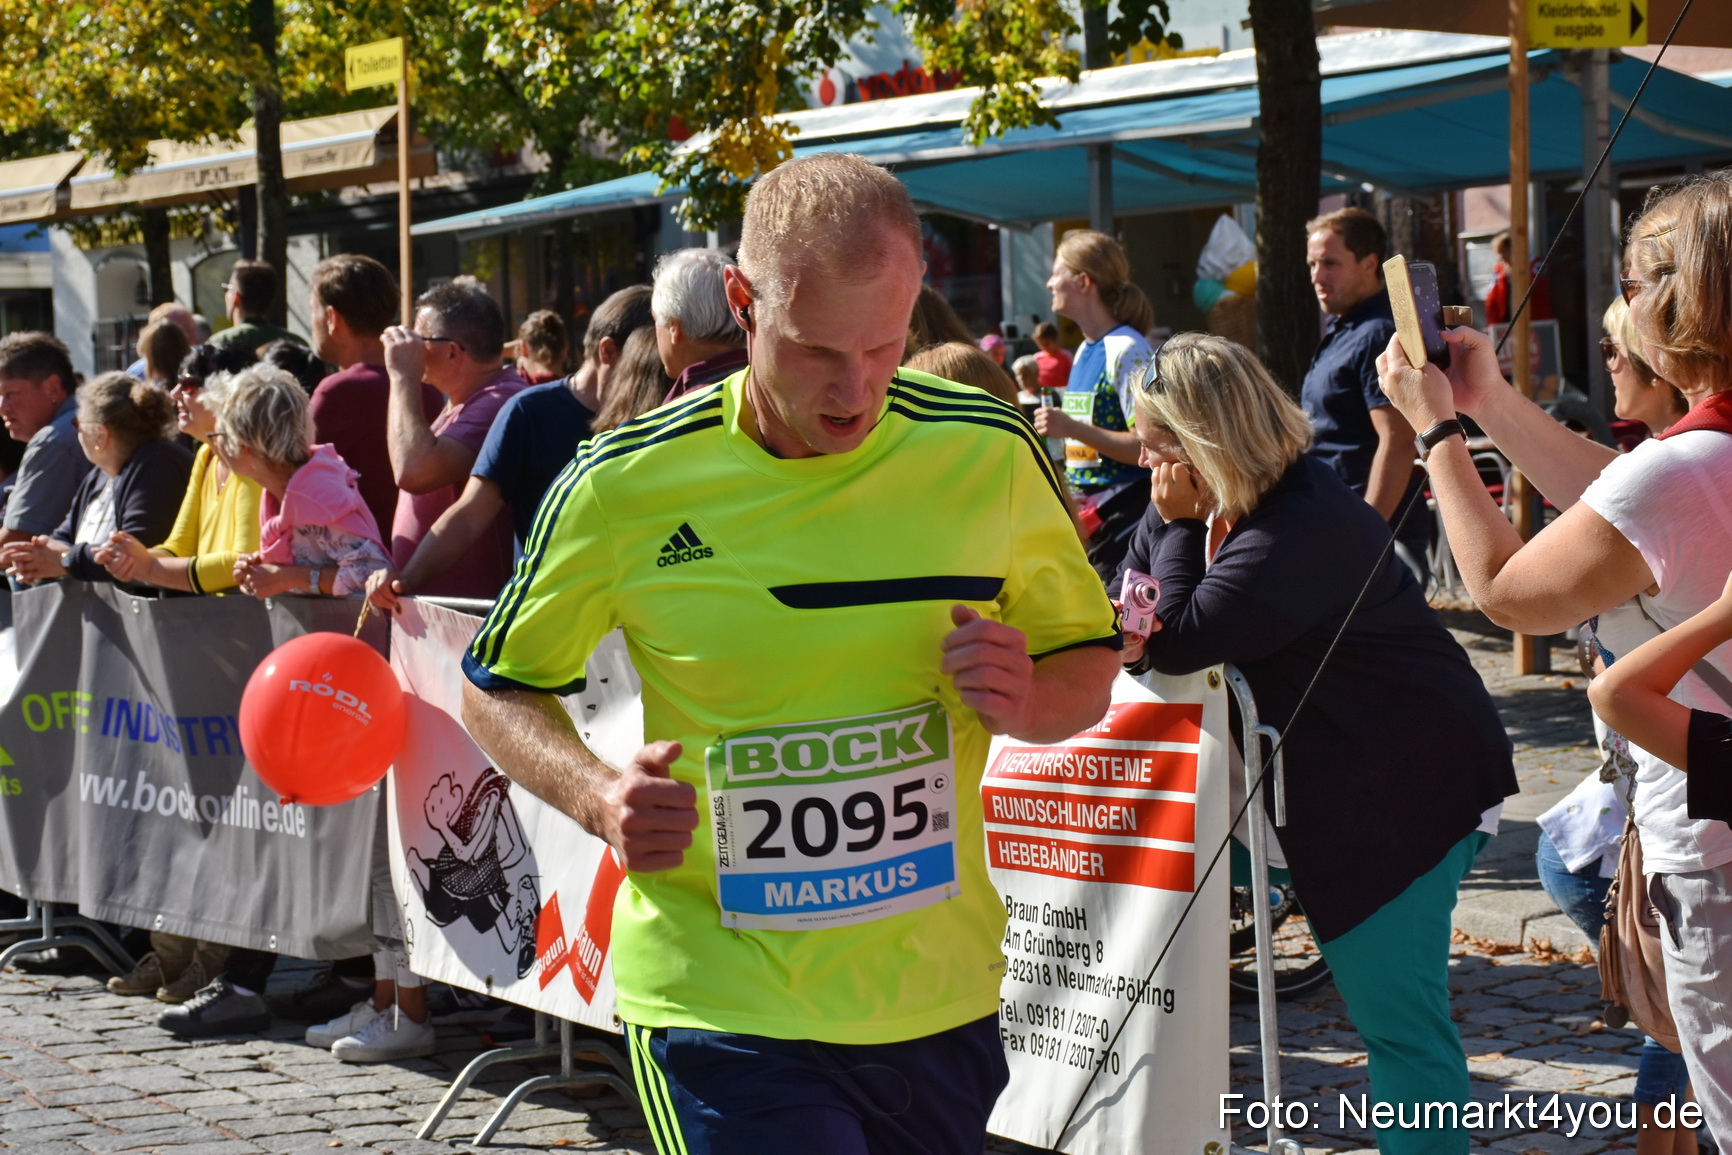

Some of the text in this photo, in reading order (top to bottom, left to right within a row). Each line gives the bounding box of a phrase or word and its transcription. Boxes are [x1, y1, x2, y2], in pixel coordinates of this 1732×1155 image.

[1554, 23, 1605, 41] ausgabe
[656, 547, 714, 568] adidas
[727, 714, 932, 781] BOCK
[999, 752, 1153, 783] VERZURRSYSTEME
[742, 777, 929, 860] 2095
[991, 795, 1137, 831] RUNDSCHLINGEN
[998, 840, 1105, 877] HEBEBÄNDER
[763, 861, 919, 909] MARKUS
[1005, 894, 1088, 931] Braun GmbH
[1004, 924, 1021, 951] Am
[1024, 928, 1091, 967] Grünberg
[1096, 939, 1104, 964] 8
[1056, 964, 1176, 1014] Neumarkt-Pölling
[999, 997, 1024, 1024] Tel.
[1026, 1002, 1067, 1032] 09181
[1074, 1012, 1110, 1043] 2307-0
[1000, 1027, 1026, 1053] Fax
[1030, 1032, 1063, 1061] 09181
[1069, 1042, 1121, 1076] 2307-70
